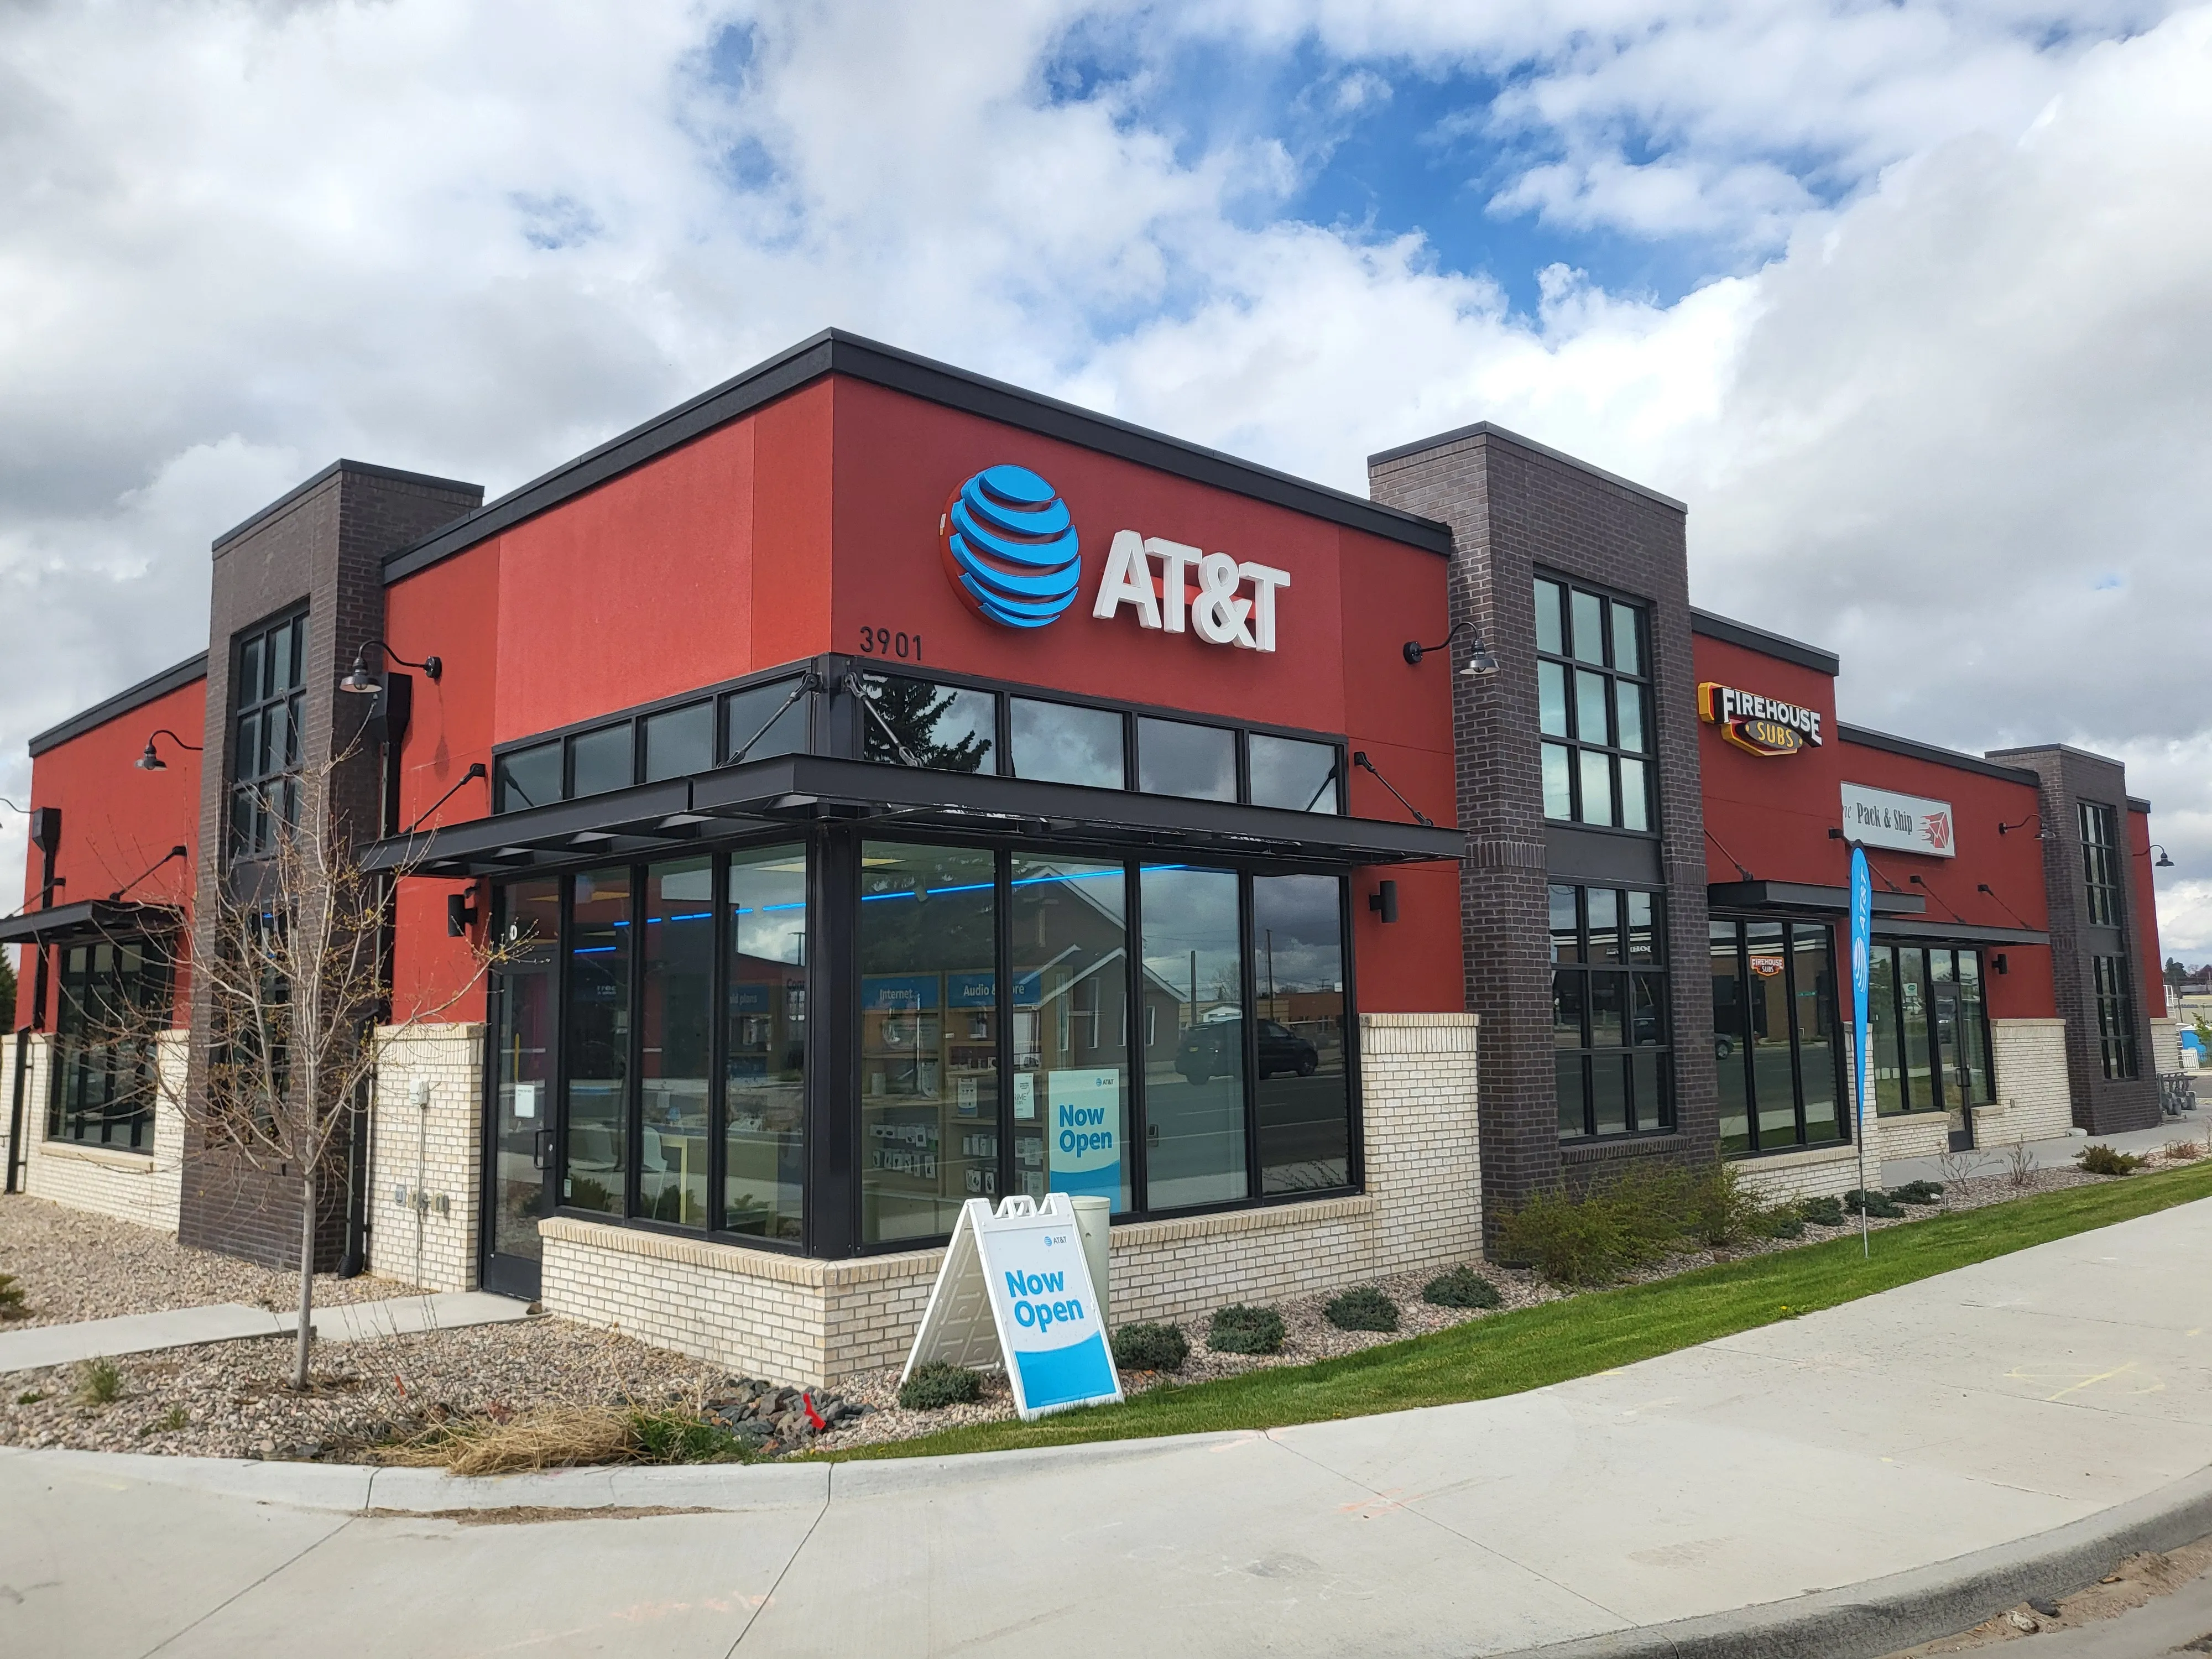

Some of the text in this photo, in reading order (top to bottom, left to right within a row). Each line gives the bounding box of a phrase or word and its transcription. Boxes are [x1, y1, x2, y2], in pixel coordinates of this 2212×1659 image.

[1092, 529, 1291, 653] AT&T
[860, 627, 922, 661] 3901
[1721, 687, 1823, 747] FIREHOUSE
[1757, 722, 1794, 748] SUBS
[1856, 802, 1881, 828] Pack
[1884, 807, 1892, 828] &
[1893, 808, 1913, 836] Ship
[1751, 958, 1783, 969] FIREHOUSE
[879, 988, 914, 1001] Internet
[963, 984, 990, 997] Audio
[1059, 1104, 1105, 1128] Now
[1059, 1129, 1113, 1158] Open
[1053, 1236, 1067, 1244] AT&T
[1005, 1270, 1065, 1297] Now
[1014, 1299, 1084, 1333] Open
